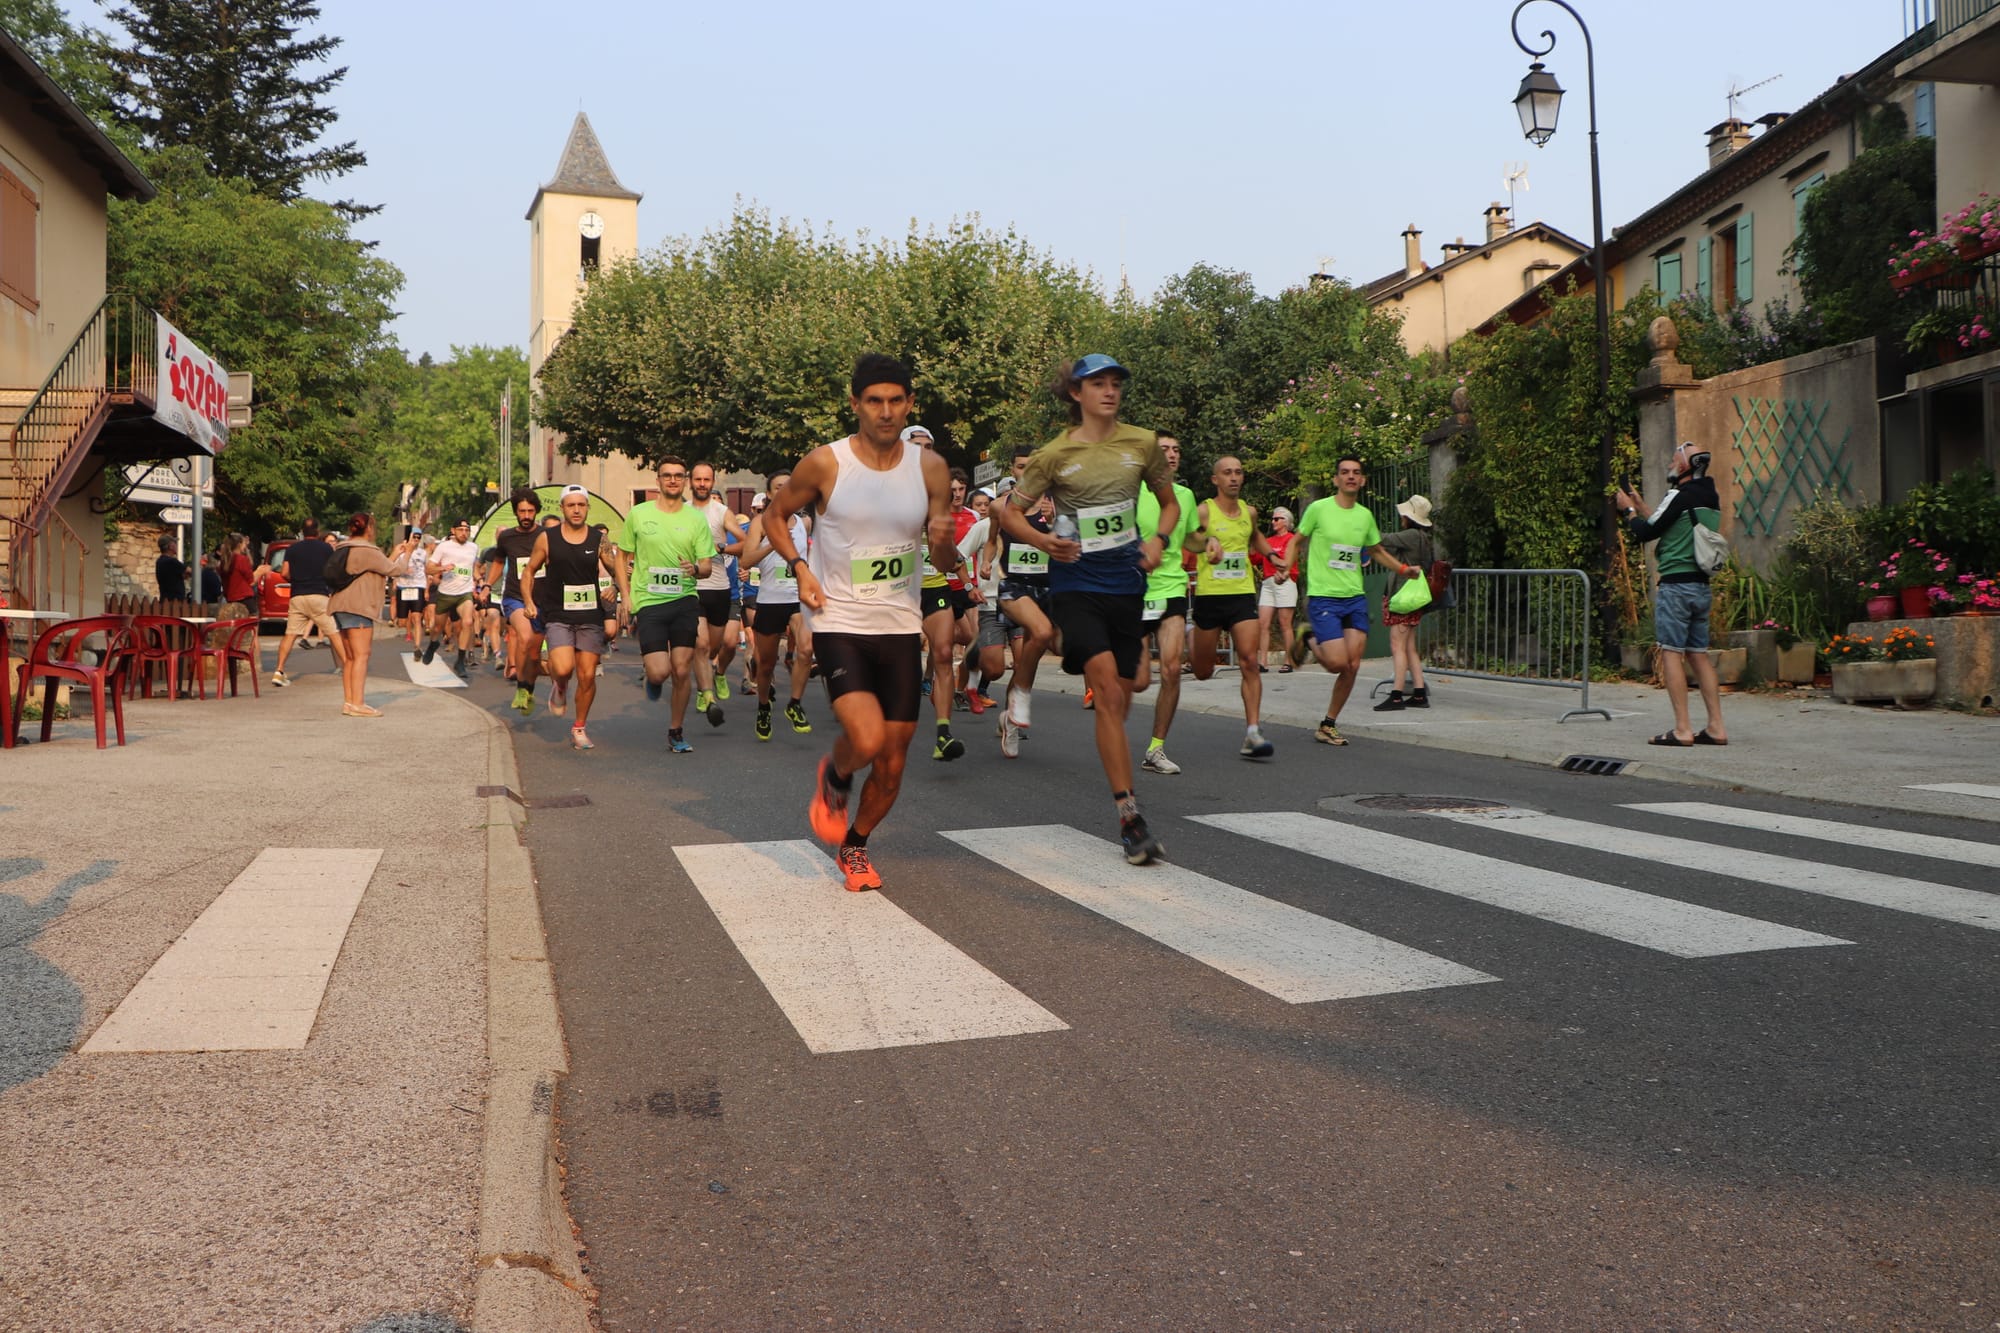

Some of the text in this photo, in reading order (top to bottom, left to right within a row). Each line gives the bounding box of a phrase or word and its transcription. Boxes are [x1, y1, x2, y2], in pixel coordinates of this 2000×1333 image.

[1094, 515, 1124, 536] 93
[1018, 552, 1039, 565] 49
[1338, 551, 1353, 562] 25
[870, 557, 903, 581] 20
[1224, 559, 1240, 570] 14
[599, 580, 610, 588] 09
[653, 573, 679, 586] 105
[573, 591, 588, 603] 31
